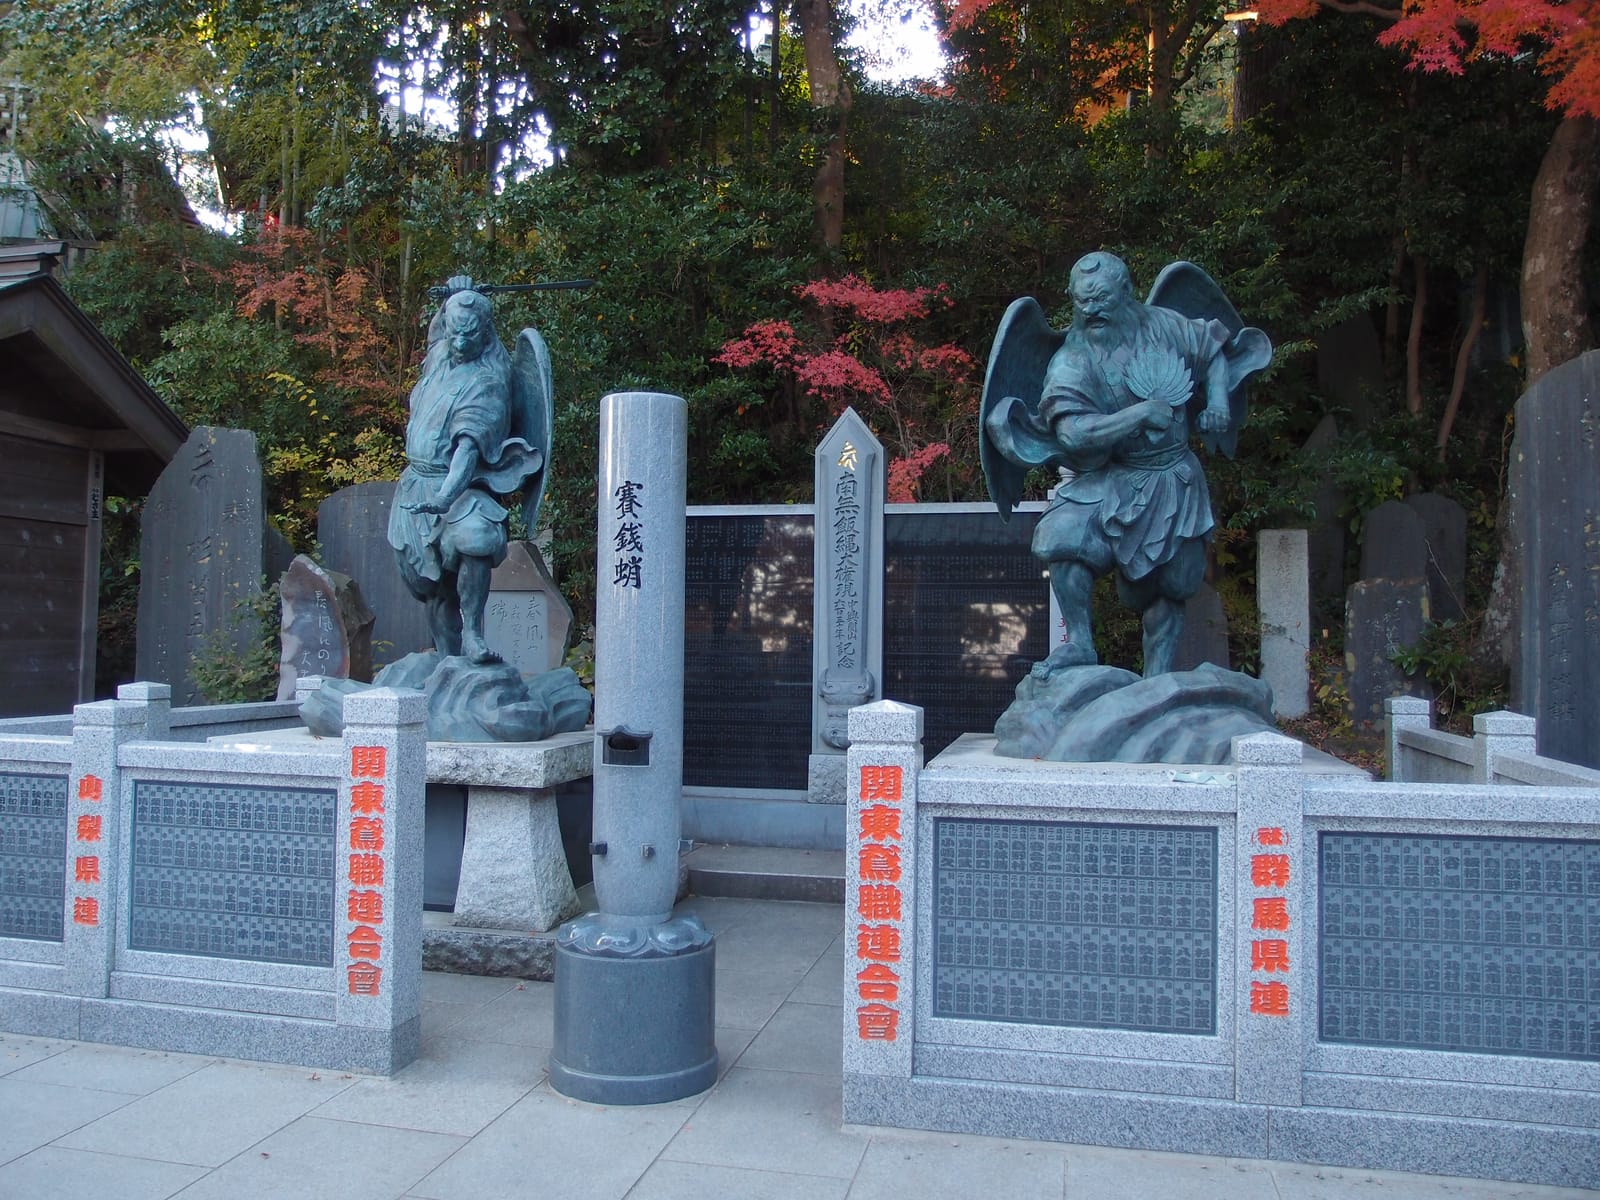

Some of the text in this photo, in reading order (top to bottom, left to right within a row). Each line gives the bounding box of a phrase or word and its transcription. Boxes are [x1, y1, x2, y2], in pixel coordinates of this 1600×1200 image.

[613, 480, 644, 589] 賽銭蛸
[73, 774, 103, 927] 山梨県連
